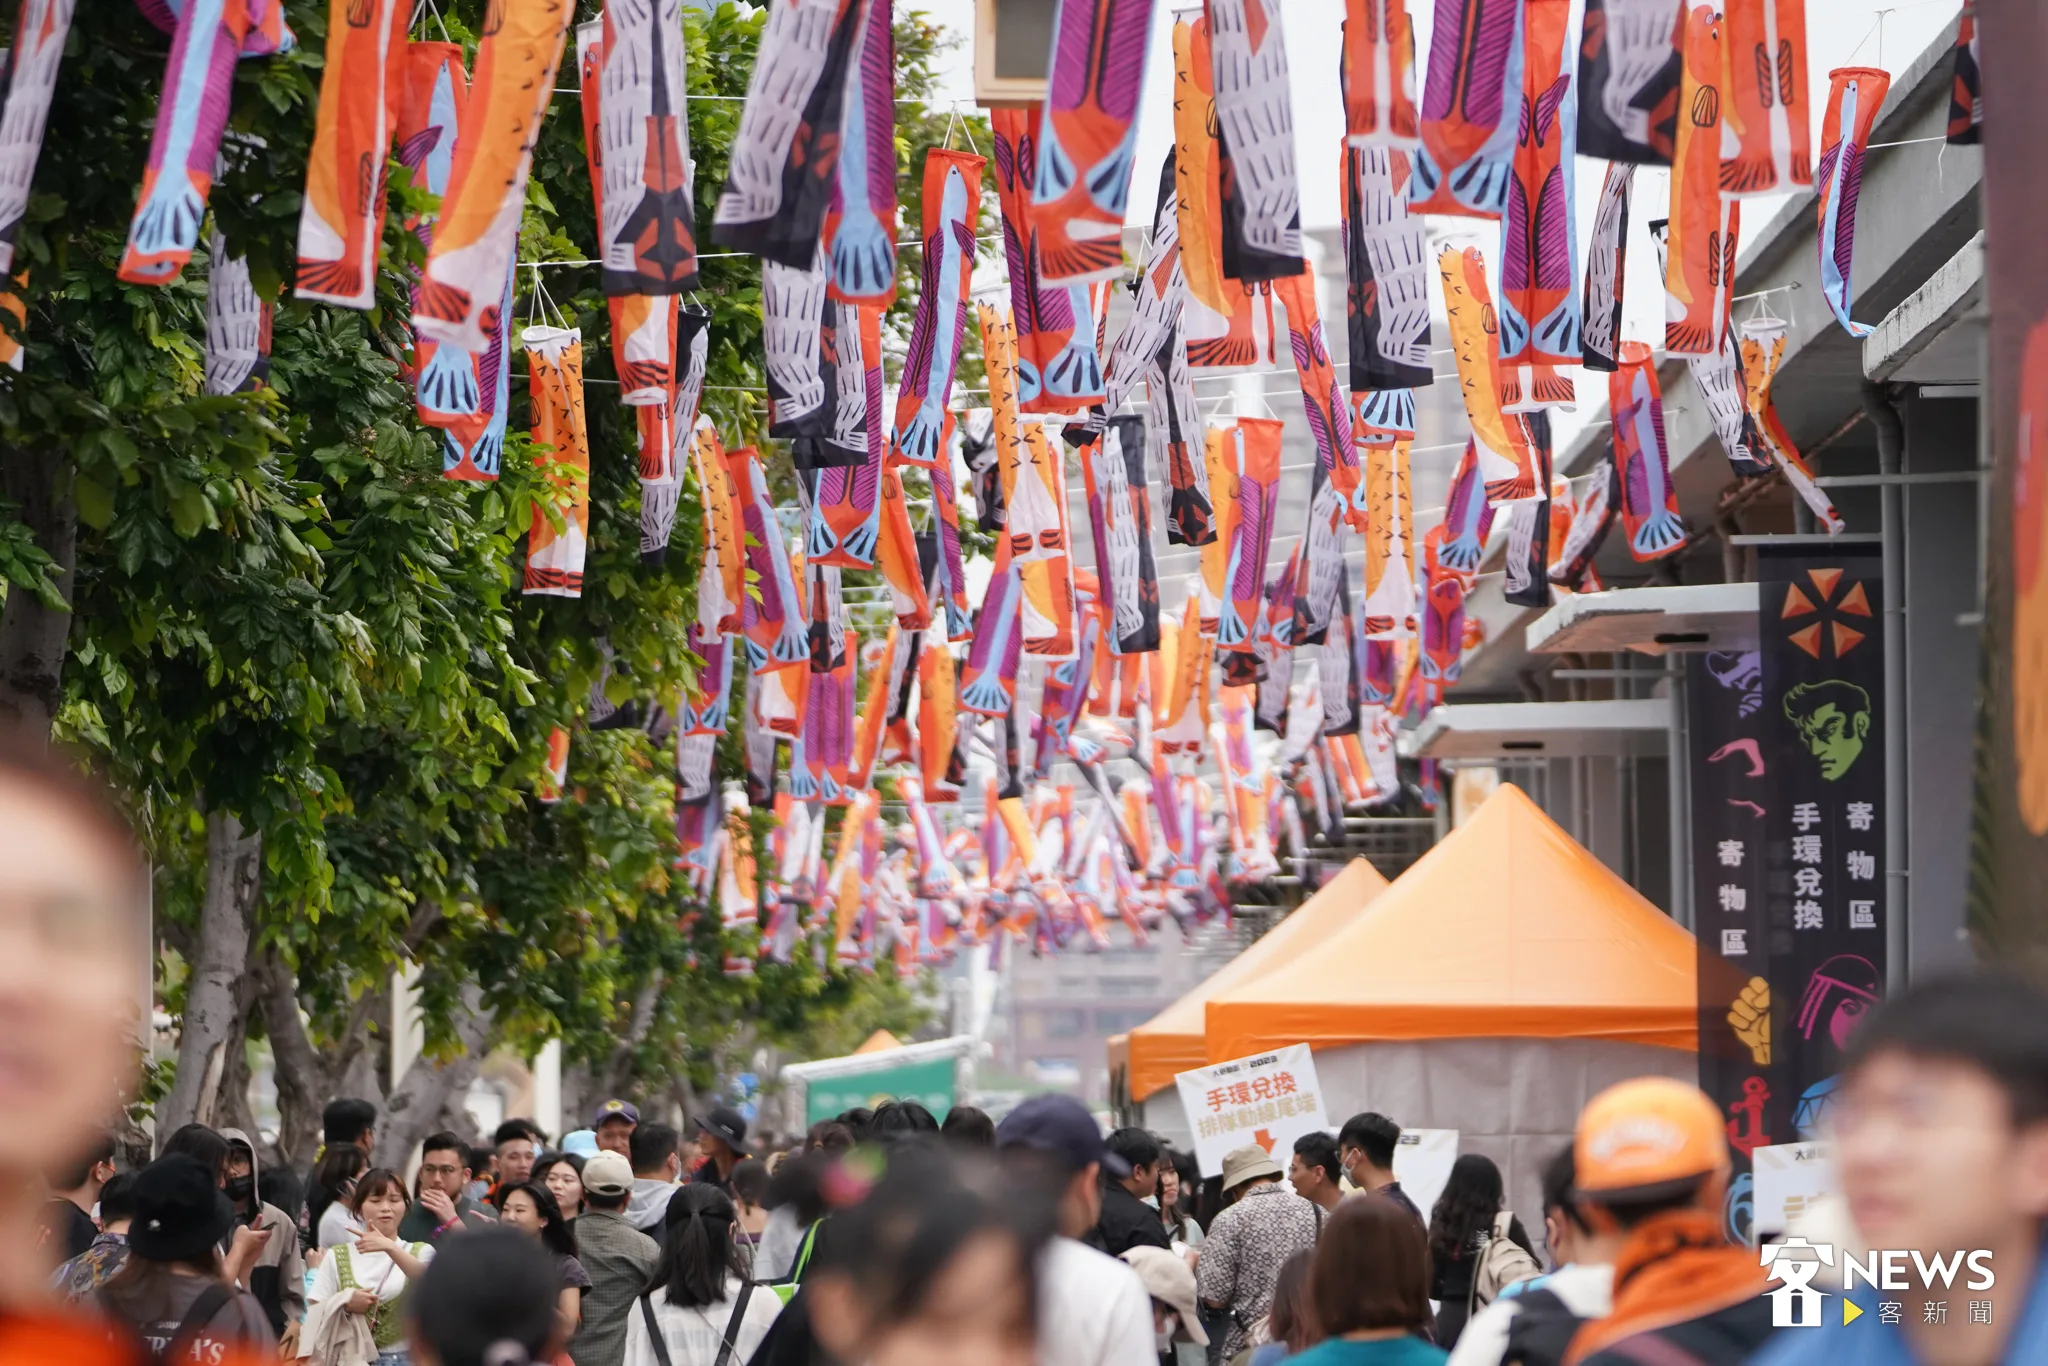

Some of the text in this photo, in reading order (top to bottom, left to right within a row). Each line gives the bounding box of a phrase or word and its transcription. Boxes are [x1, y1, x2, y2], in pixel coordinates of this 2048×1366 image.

[1717, 838, 1748, 956] 寄物區
[1791, 802, 1824, 930] 手環兌換
[1846, 801, 1877, 929] 寄物區
[1207, 1071, 1298, 1112] 手環兌換
[1249, 1055, 1278, 1068] 2023
[1198, 1092, 1318, 1139] 排隊動線尾端
